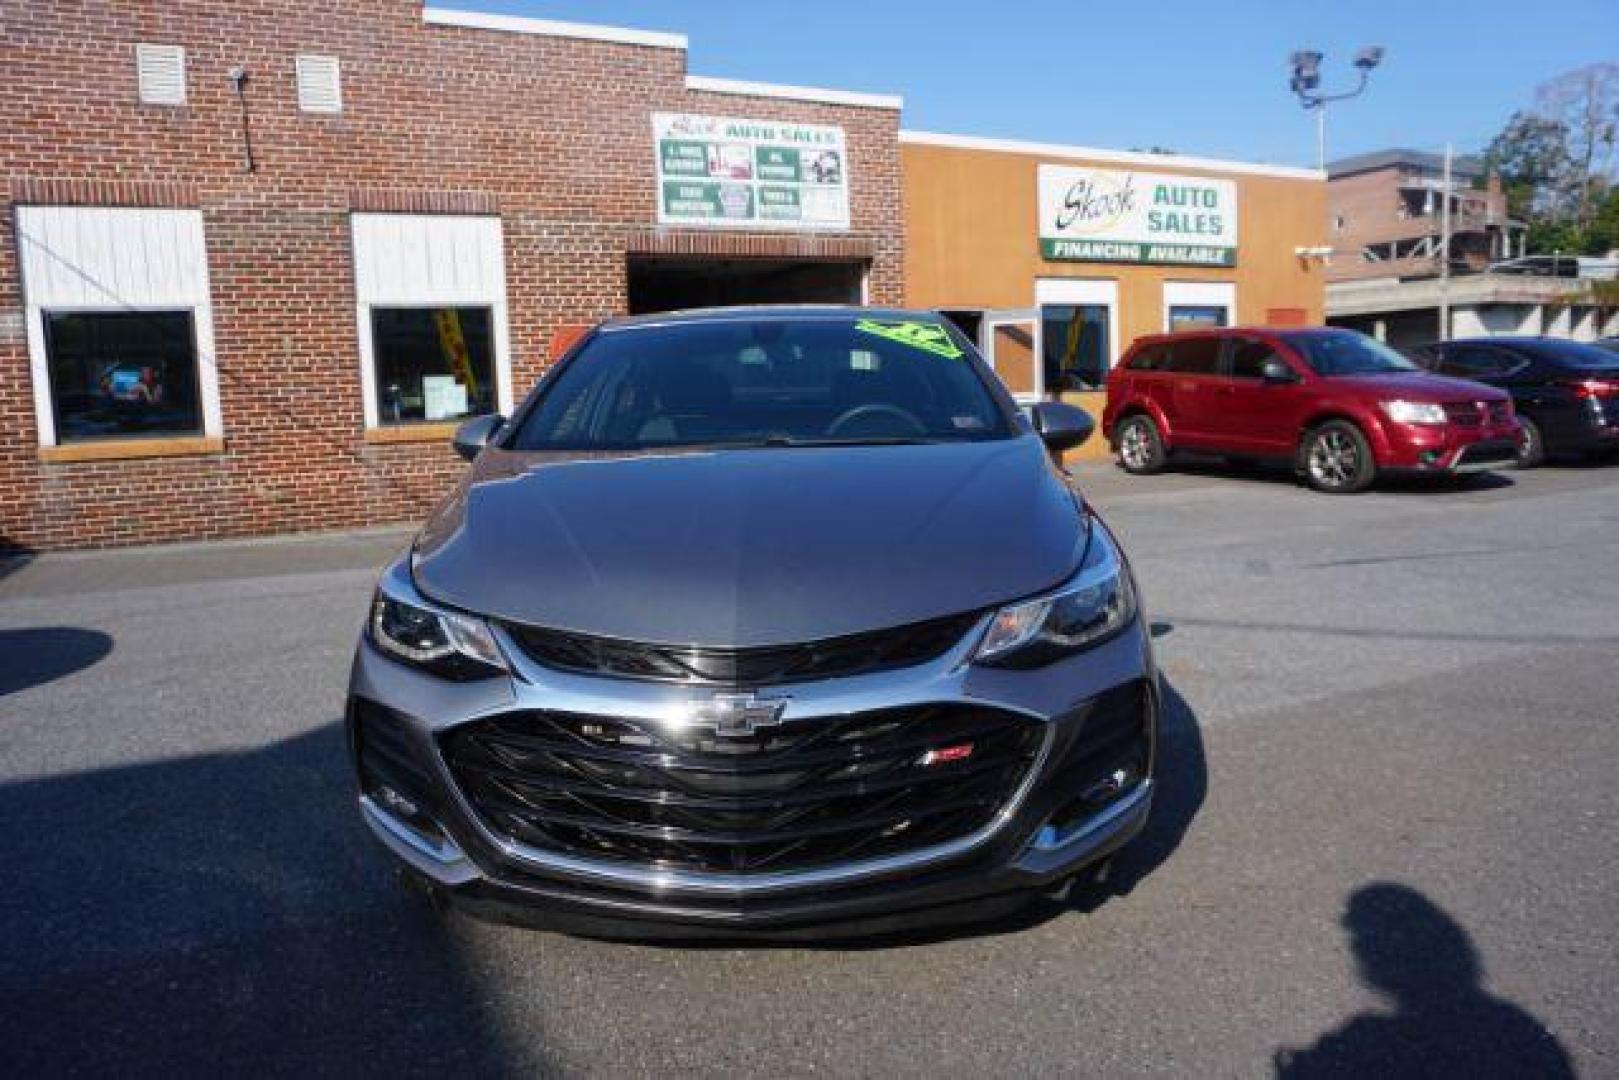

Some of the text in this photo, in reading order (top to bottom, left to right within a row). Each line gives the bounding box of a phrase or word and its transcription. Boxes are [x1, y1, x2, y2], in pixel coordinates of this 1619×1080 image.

[725, 124, 776, 140] AUTO
[781, 127, 837, 143] SALES
[1153, 184, 1218, 208] AUTO
[1148, 209, 1223, 236] SALES
[1053, 241, 1225, 263] FINANCING AVAILABLE
